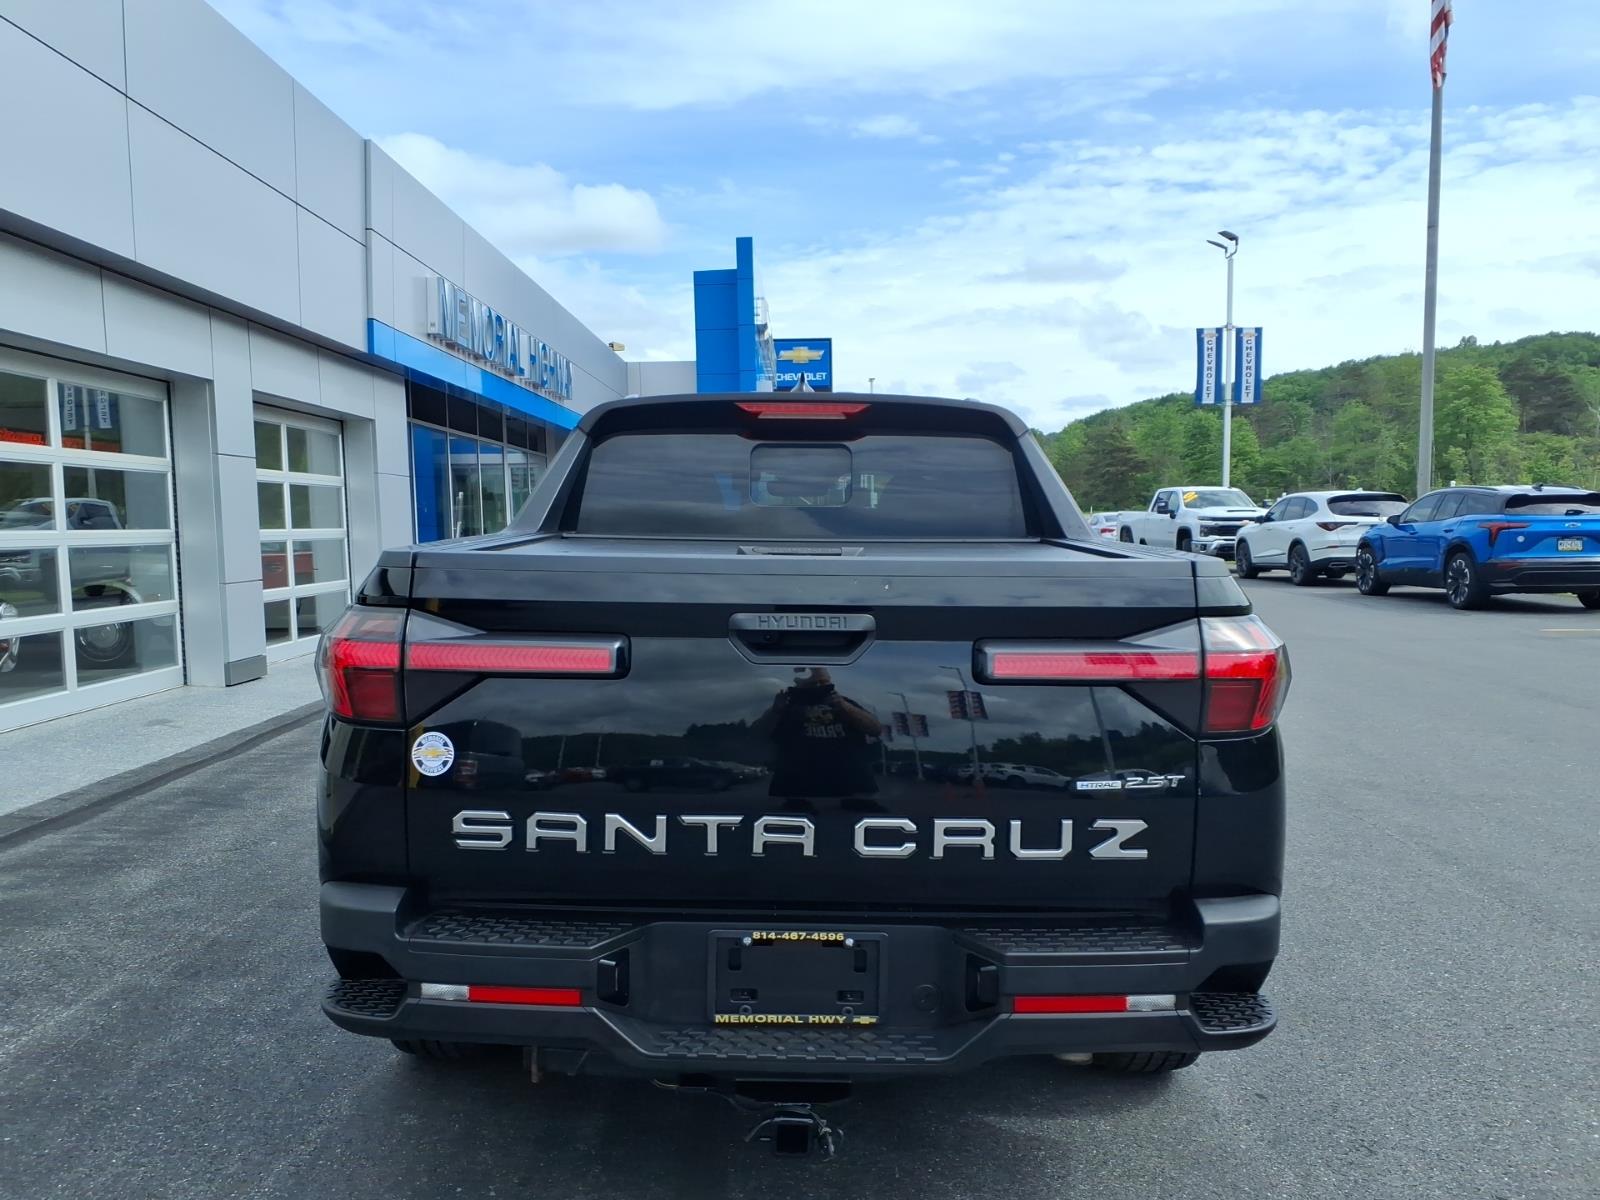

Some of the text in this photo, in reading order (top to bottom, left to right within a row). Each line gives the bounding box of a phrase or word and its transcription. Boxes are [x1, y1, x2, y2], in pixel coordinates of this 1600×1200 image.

[427, 276, 530, 378] MEMORIAL
[1206, 339, 1214, 398] CHEVROLET
[1245, 339, 1253, 397] CHEVROLET
[776, 372, 827, 381] CHEVOLET
[758, 615, 848, 629] HYUNDAI
[1079, 781, 1120, 789] HTRAC
[452, 810, 1149, 860] SANTA CRUZ
[752, 931, 844, 941] 814-467-4596
[715, 1014, 846, 1025] MEMORIAL HWY
